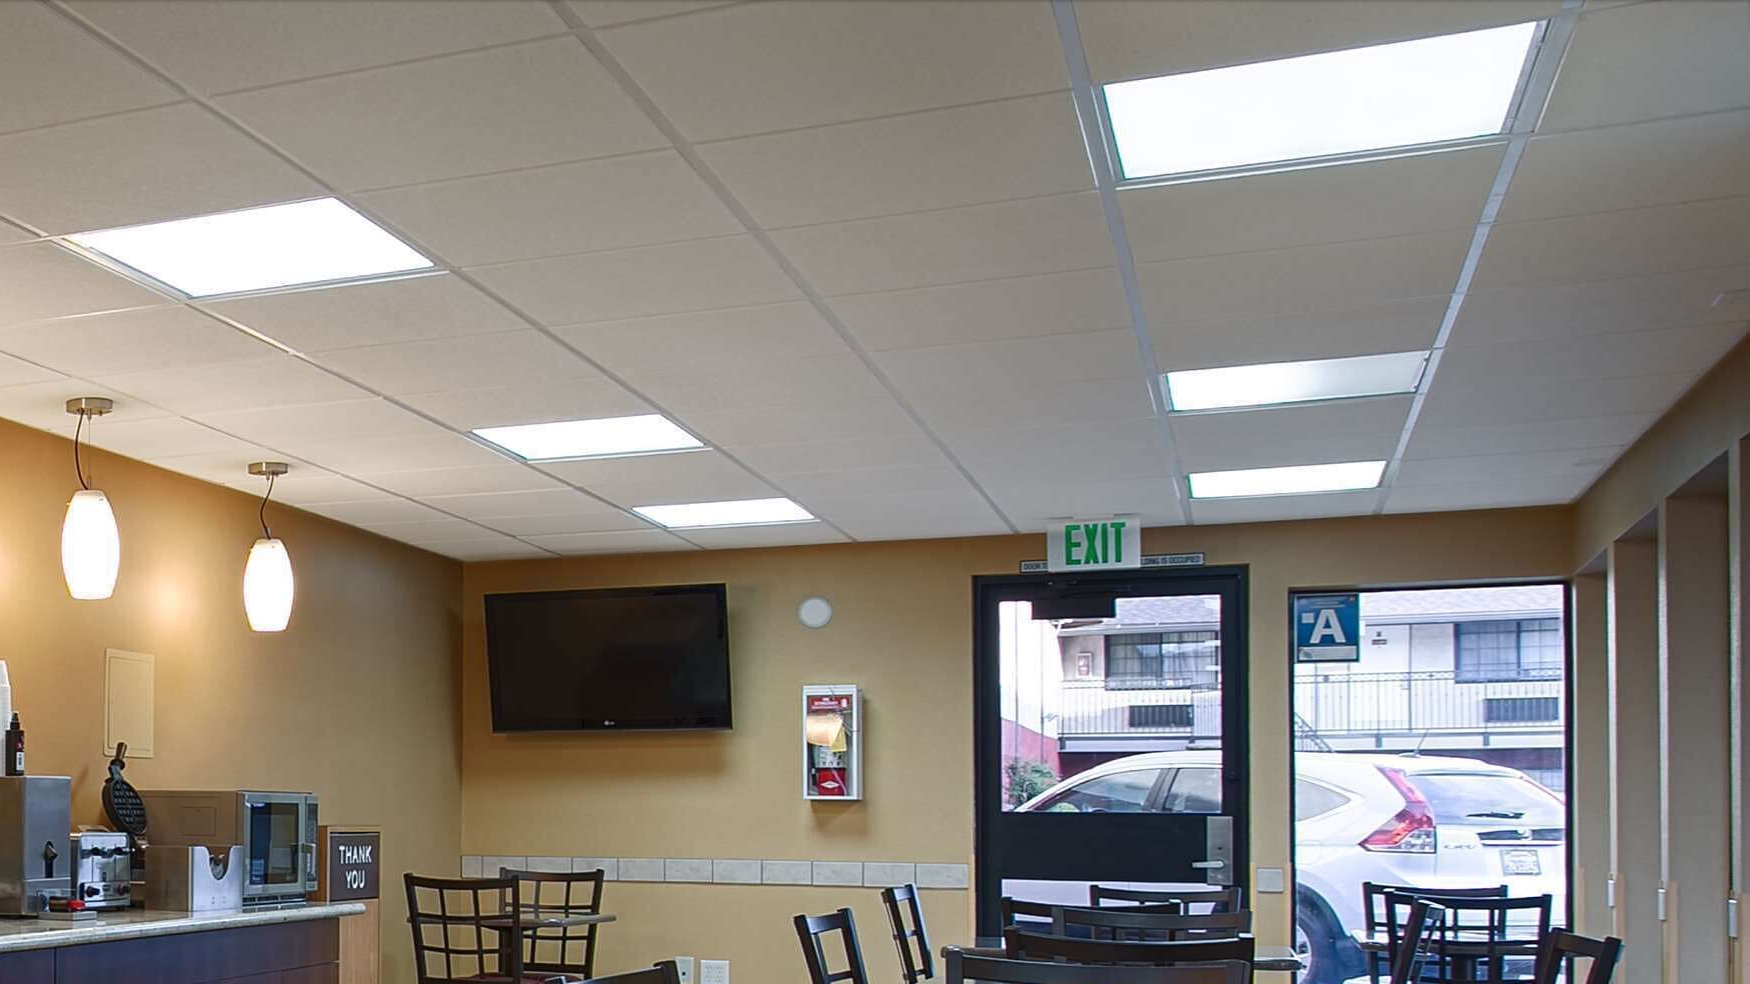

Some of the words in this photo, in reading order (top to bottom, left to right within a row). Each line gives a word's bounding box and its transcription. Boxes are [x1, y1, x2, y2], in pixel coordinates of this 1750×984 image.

[1065, 522, 1126, 565] EXIT
[1309, 609, 1347, 643] A
[338, 845, 372, 865] THANK
[345, 869, 366, 889] YOU
